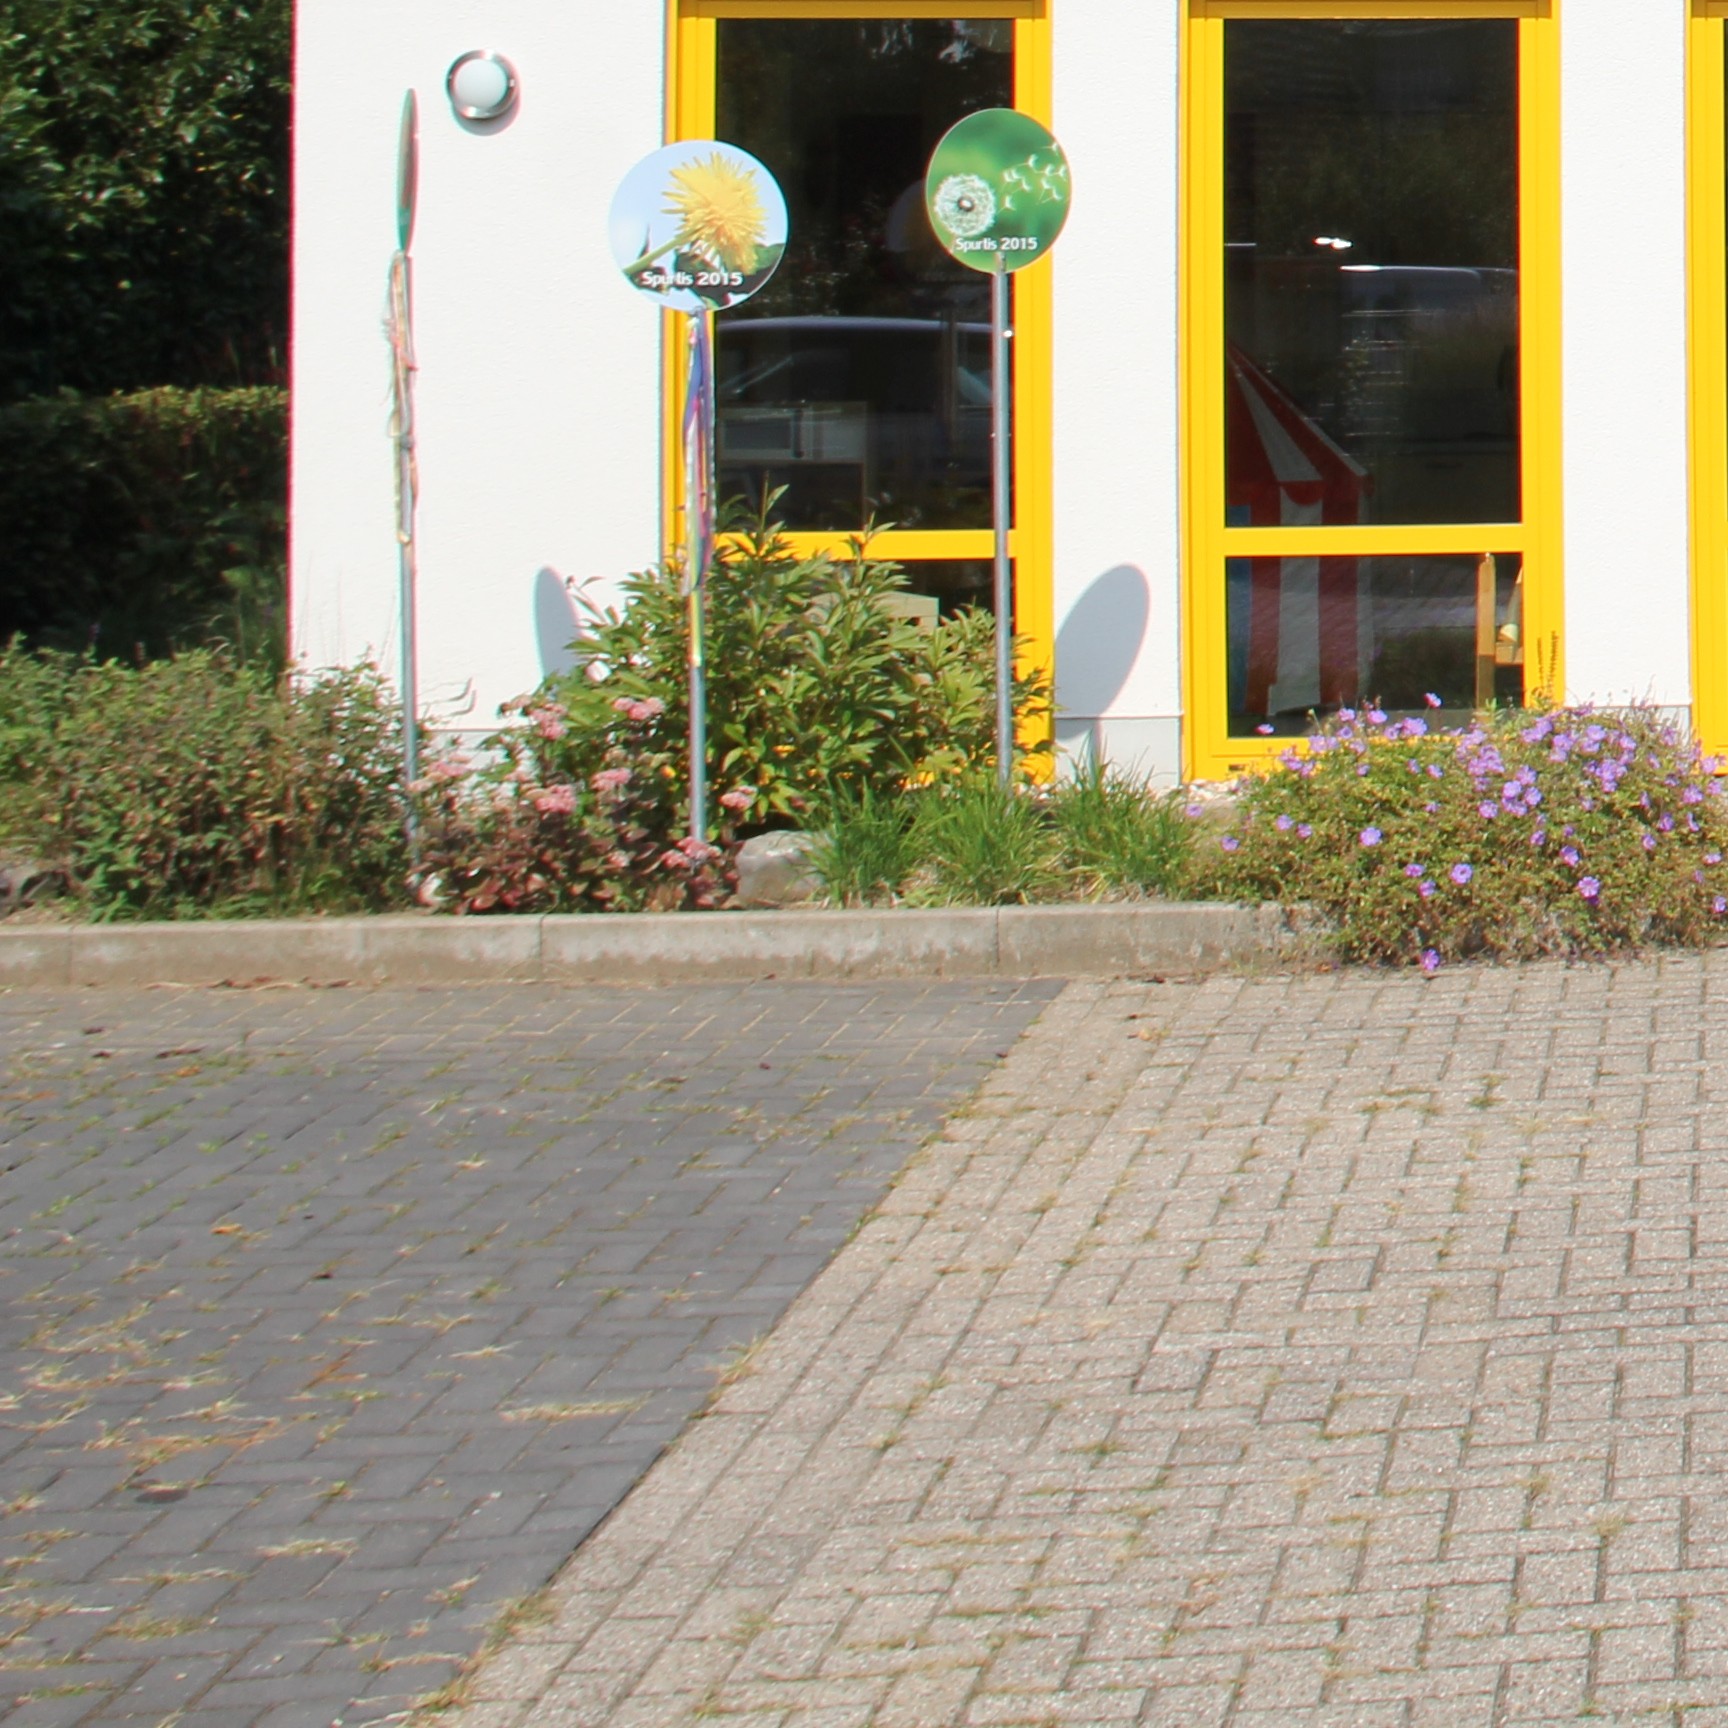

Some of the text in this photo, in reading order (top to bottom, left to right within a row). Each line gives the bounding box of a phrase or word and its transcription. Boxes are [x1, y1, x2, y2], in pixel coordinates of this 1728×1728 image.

[955, 237, 1038, 253] Spurtis 2015
[641, 271, 743, 287] Spurtis 2015
